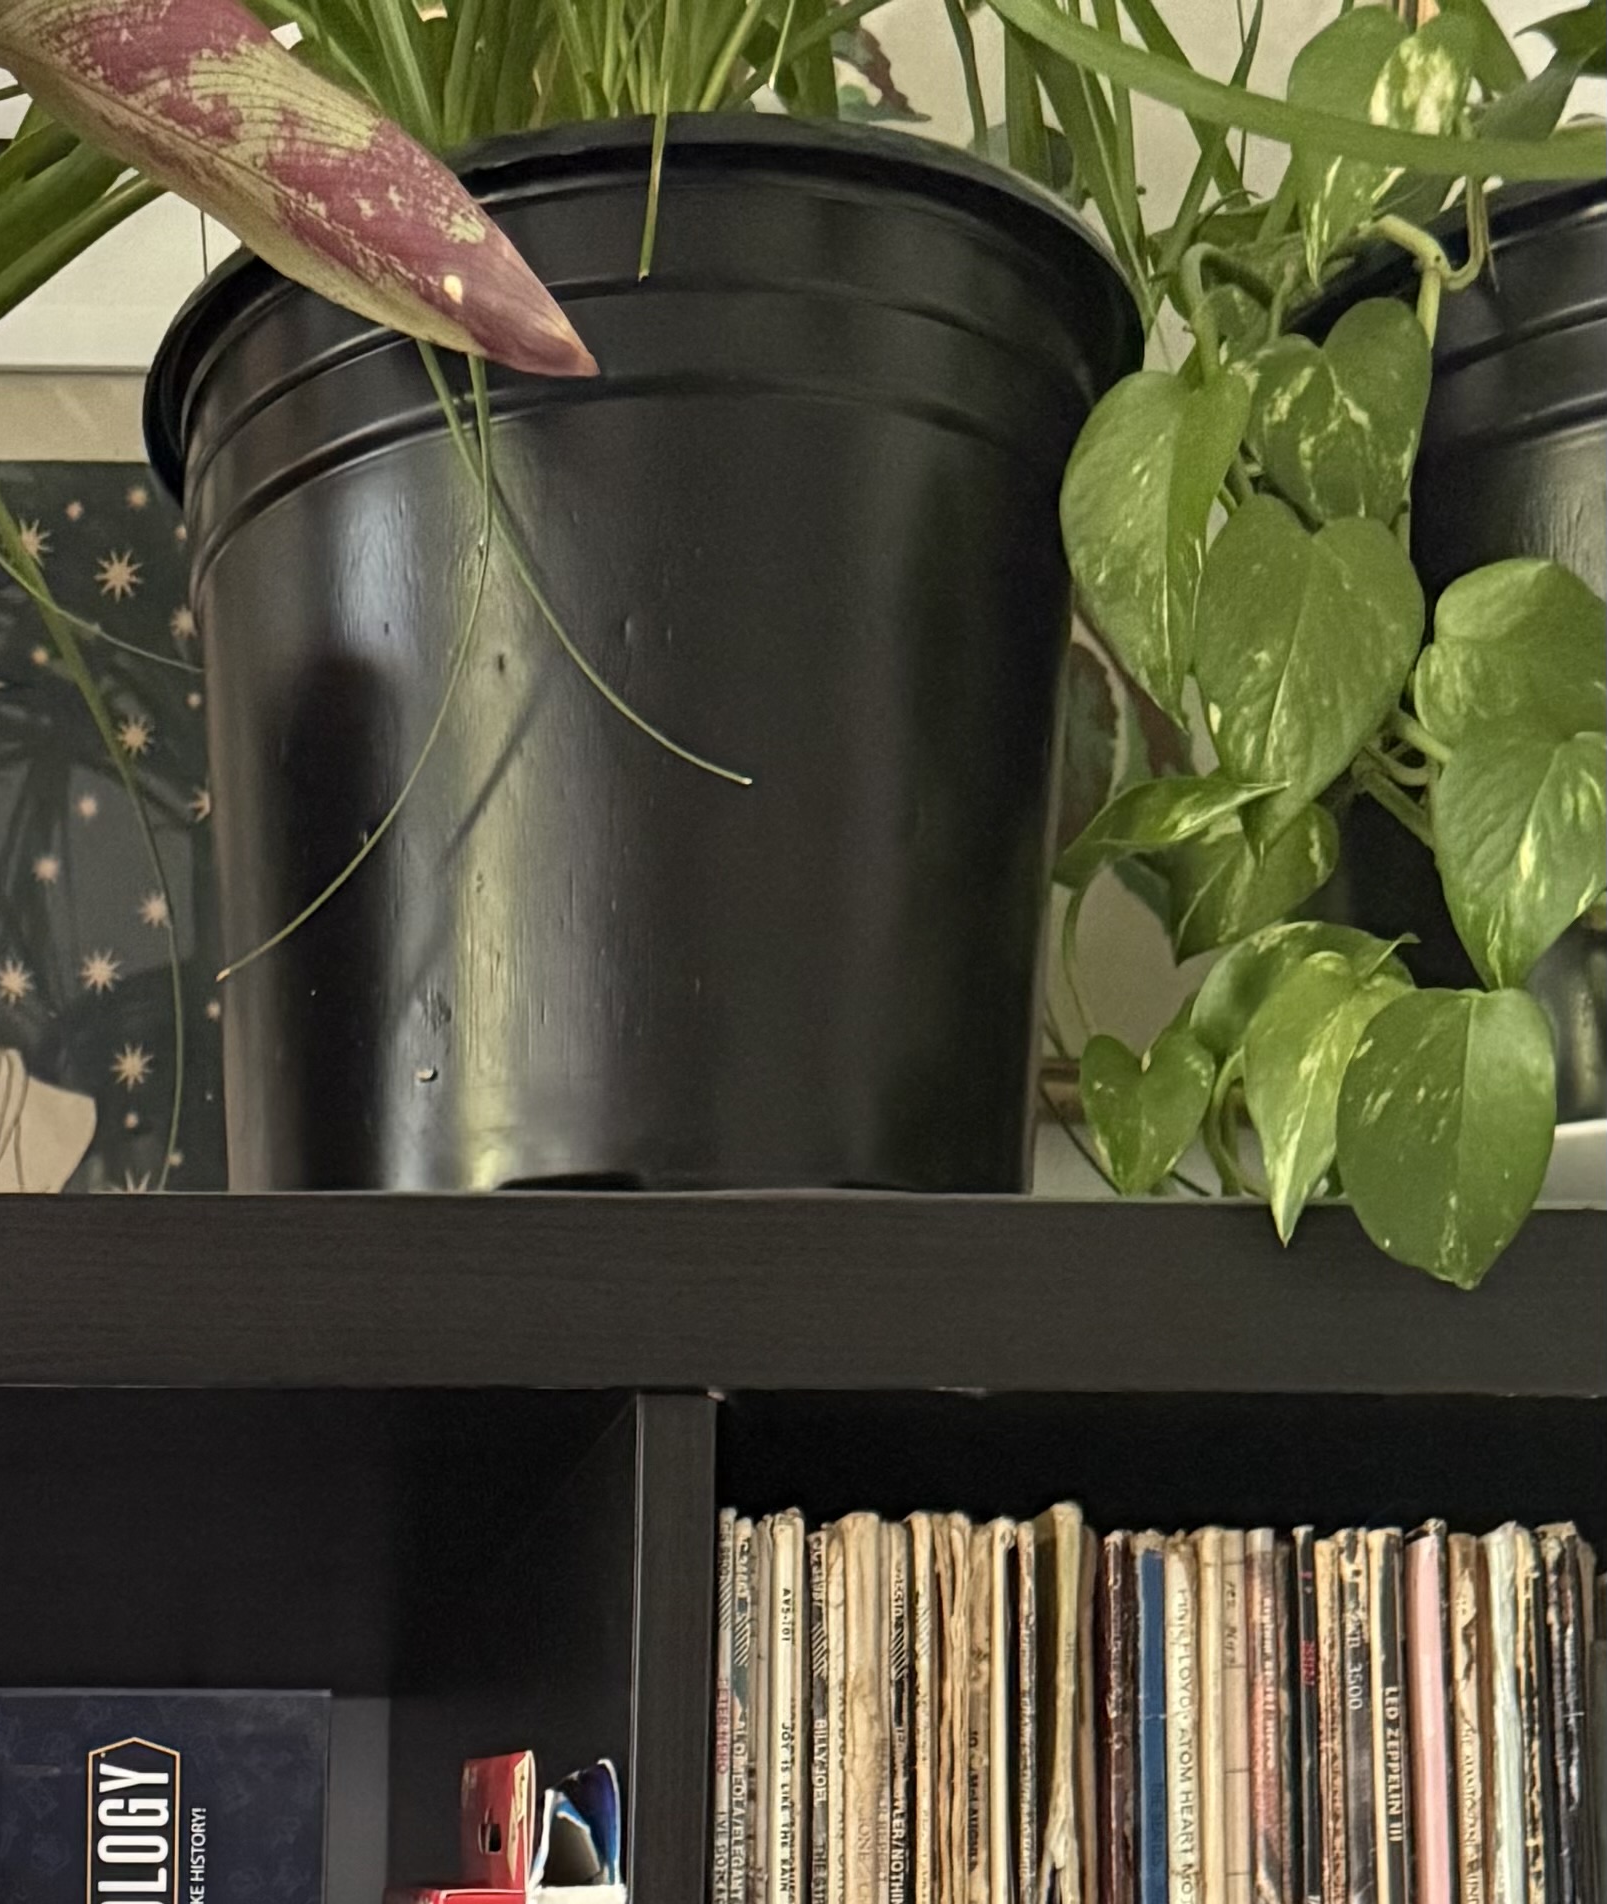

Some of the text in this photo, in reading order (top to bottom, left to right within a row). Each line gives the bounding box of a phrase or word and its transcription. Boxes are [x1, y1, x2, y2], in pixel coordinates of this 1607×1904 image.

[1385, 1687, 1402, 1842] LED ZEPPELIN III
[191, 1807, 206, 1882] HISTORY!
[1180, 1790, 1195, 1854] HEART
